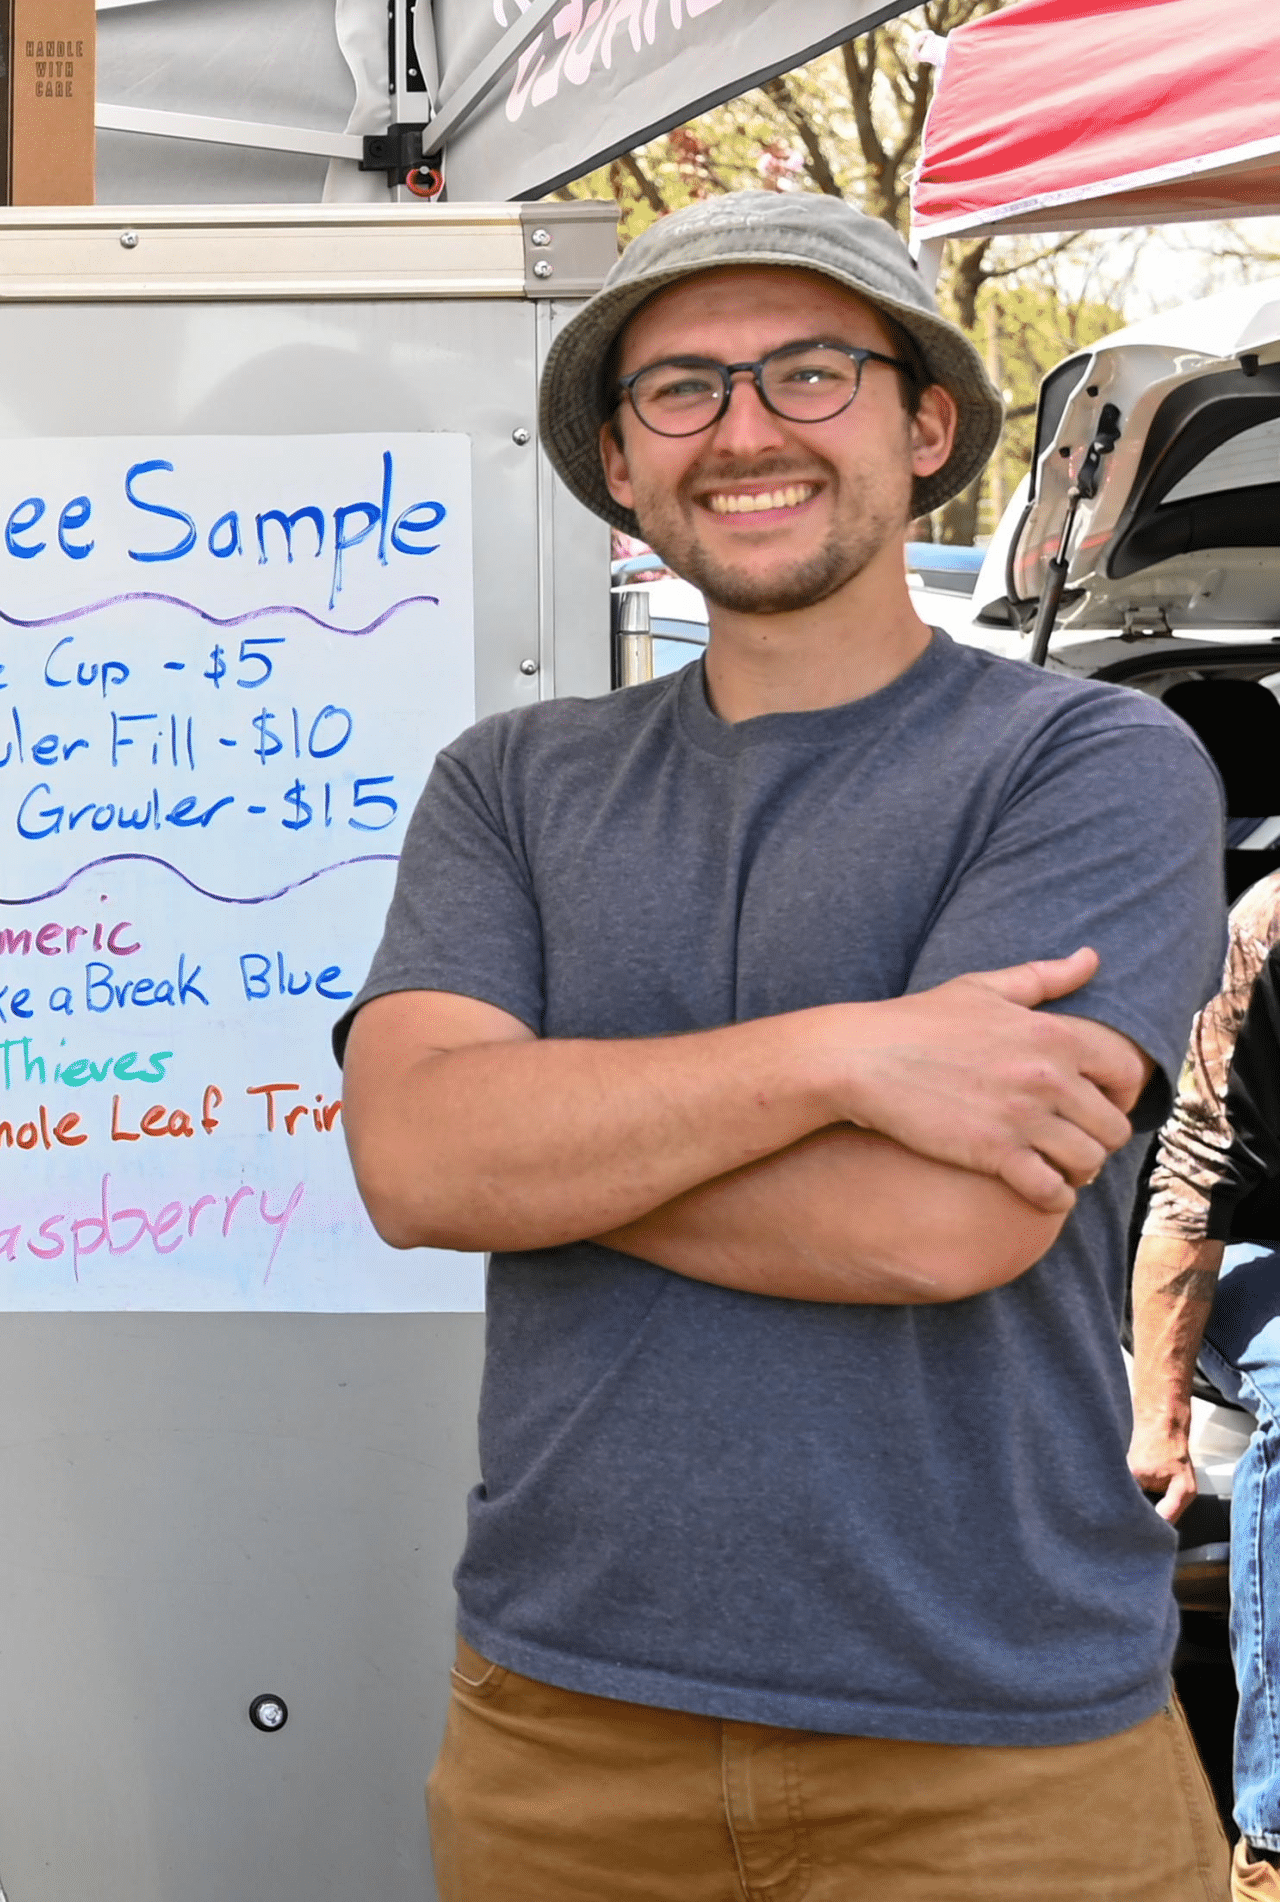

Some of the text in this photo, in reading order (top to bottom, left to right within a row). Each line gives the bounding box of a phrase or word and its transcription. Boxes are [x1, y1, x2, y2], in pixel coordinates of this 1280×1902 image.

[25, 40, 84, 58] HANDLE
[35, 61, 74, 78] WITH
[35, 80, 73, 98] CARE
[124, 450, 448, 611] Sample
[44, 635, 131, 698] Cup
[110, 711, 196, 769] Fill
[16, 783, 236, 841] Growler
[84, 952, 211, 1014] Break
[238, 951, 354, 1001] Blue
[110, 1084, 225, 1143] Leaf
